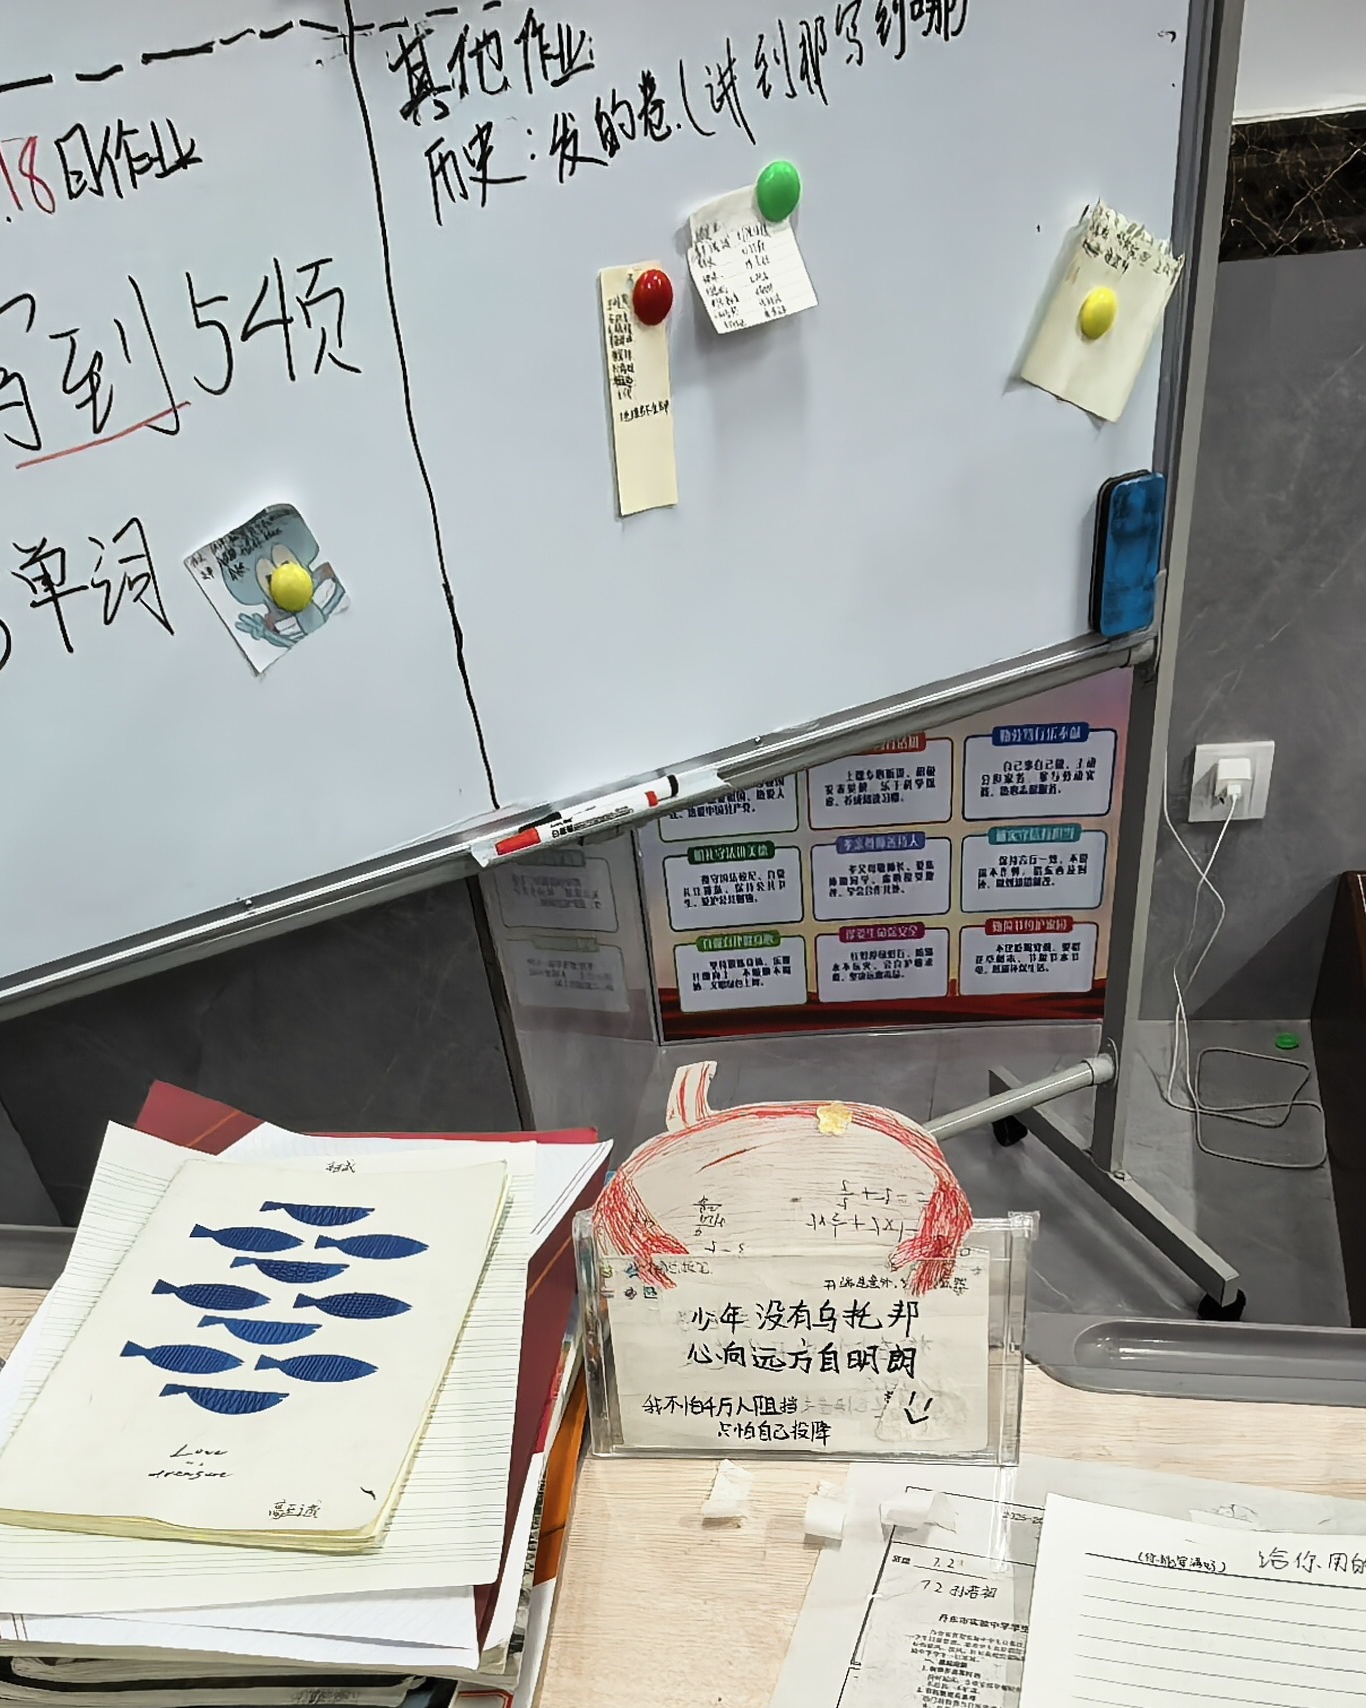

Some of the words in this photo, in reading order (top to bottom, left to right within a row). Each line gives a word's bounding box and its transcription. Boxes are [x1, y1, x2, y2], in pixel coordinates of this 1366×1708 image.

[691, 1300, 921, 1338] 少年没有乌托邦
[686, 1339, 917, 1379] 心向远方自明朗
